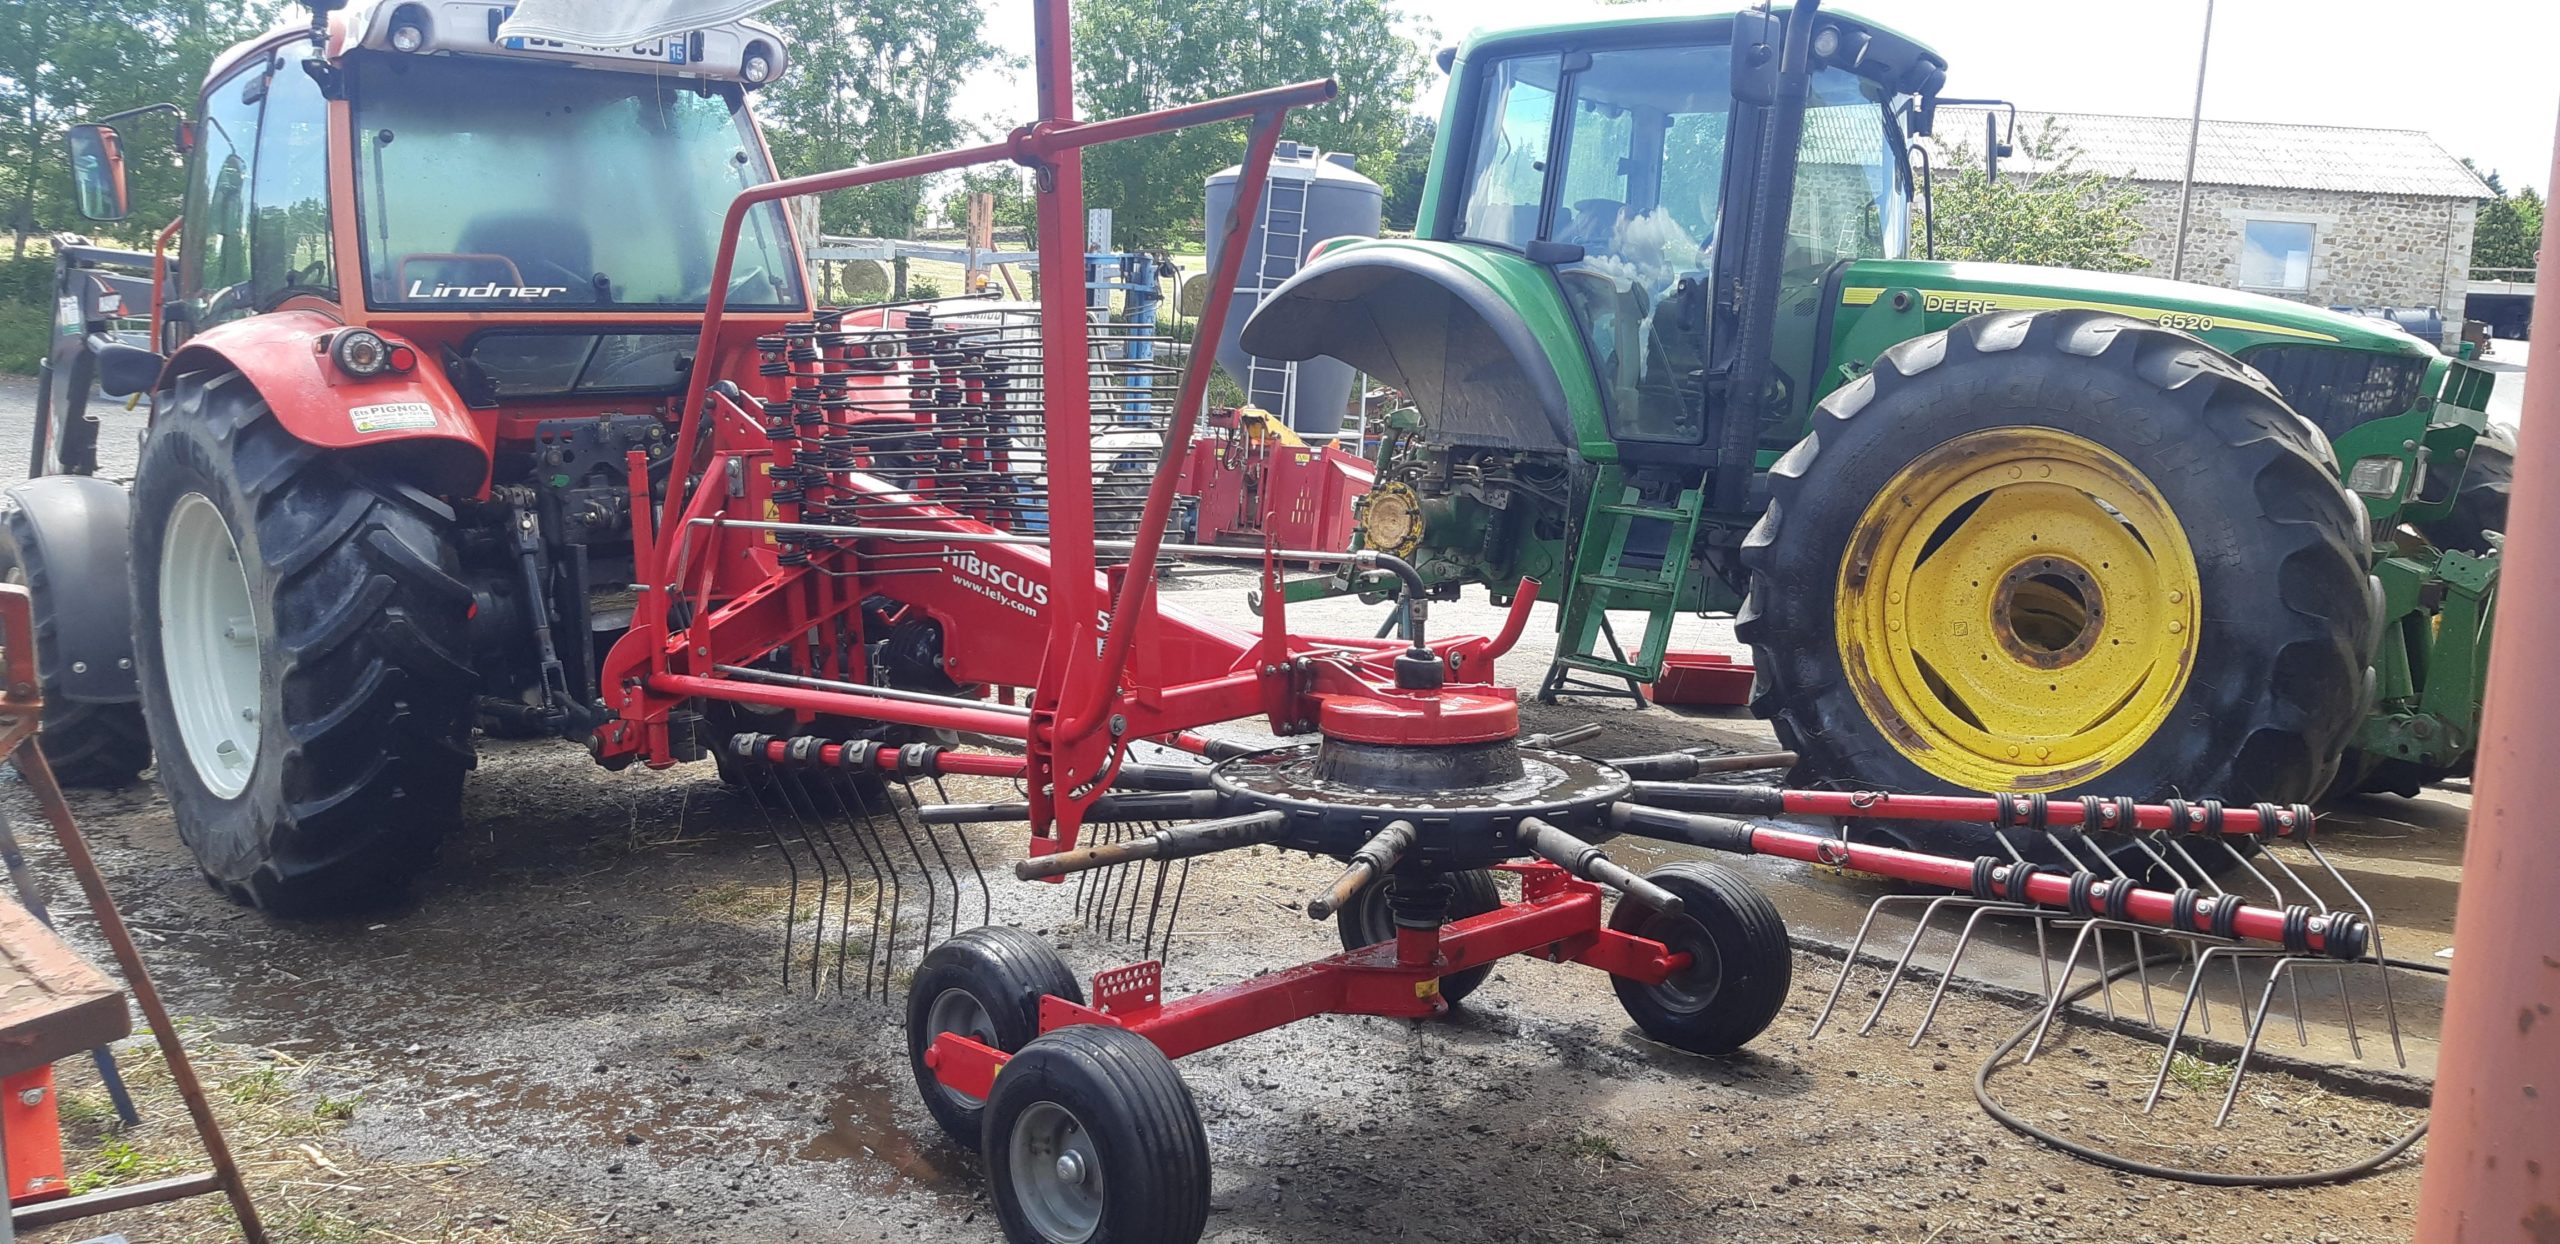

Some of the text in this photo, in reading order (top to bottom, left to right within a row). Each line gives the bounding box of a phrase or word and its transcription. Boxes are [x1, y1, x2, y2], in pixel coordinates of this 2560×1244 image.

[670, 46, 684, 60] 15
[408, 280, 567, 297] Lindner
[1925, 295, 1996, 314] DEERE
[2159, 313, 2214, 331] 6520
[370, 405, 428, 414] PIGNOL
[942, 545, 1048, 605] HIBISCUS
[952, 574, 1037, 617] www.lely.com
